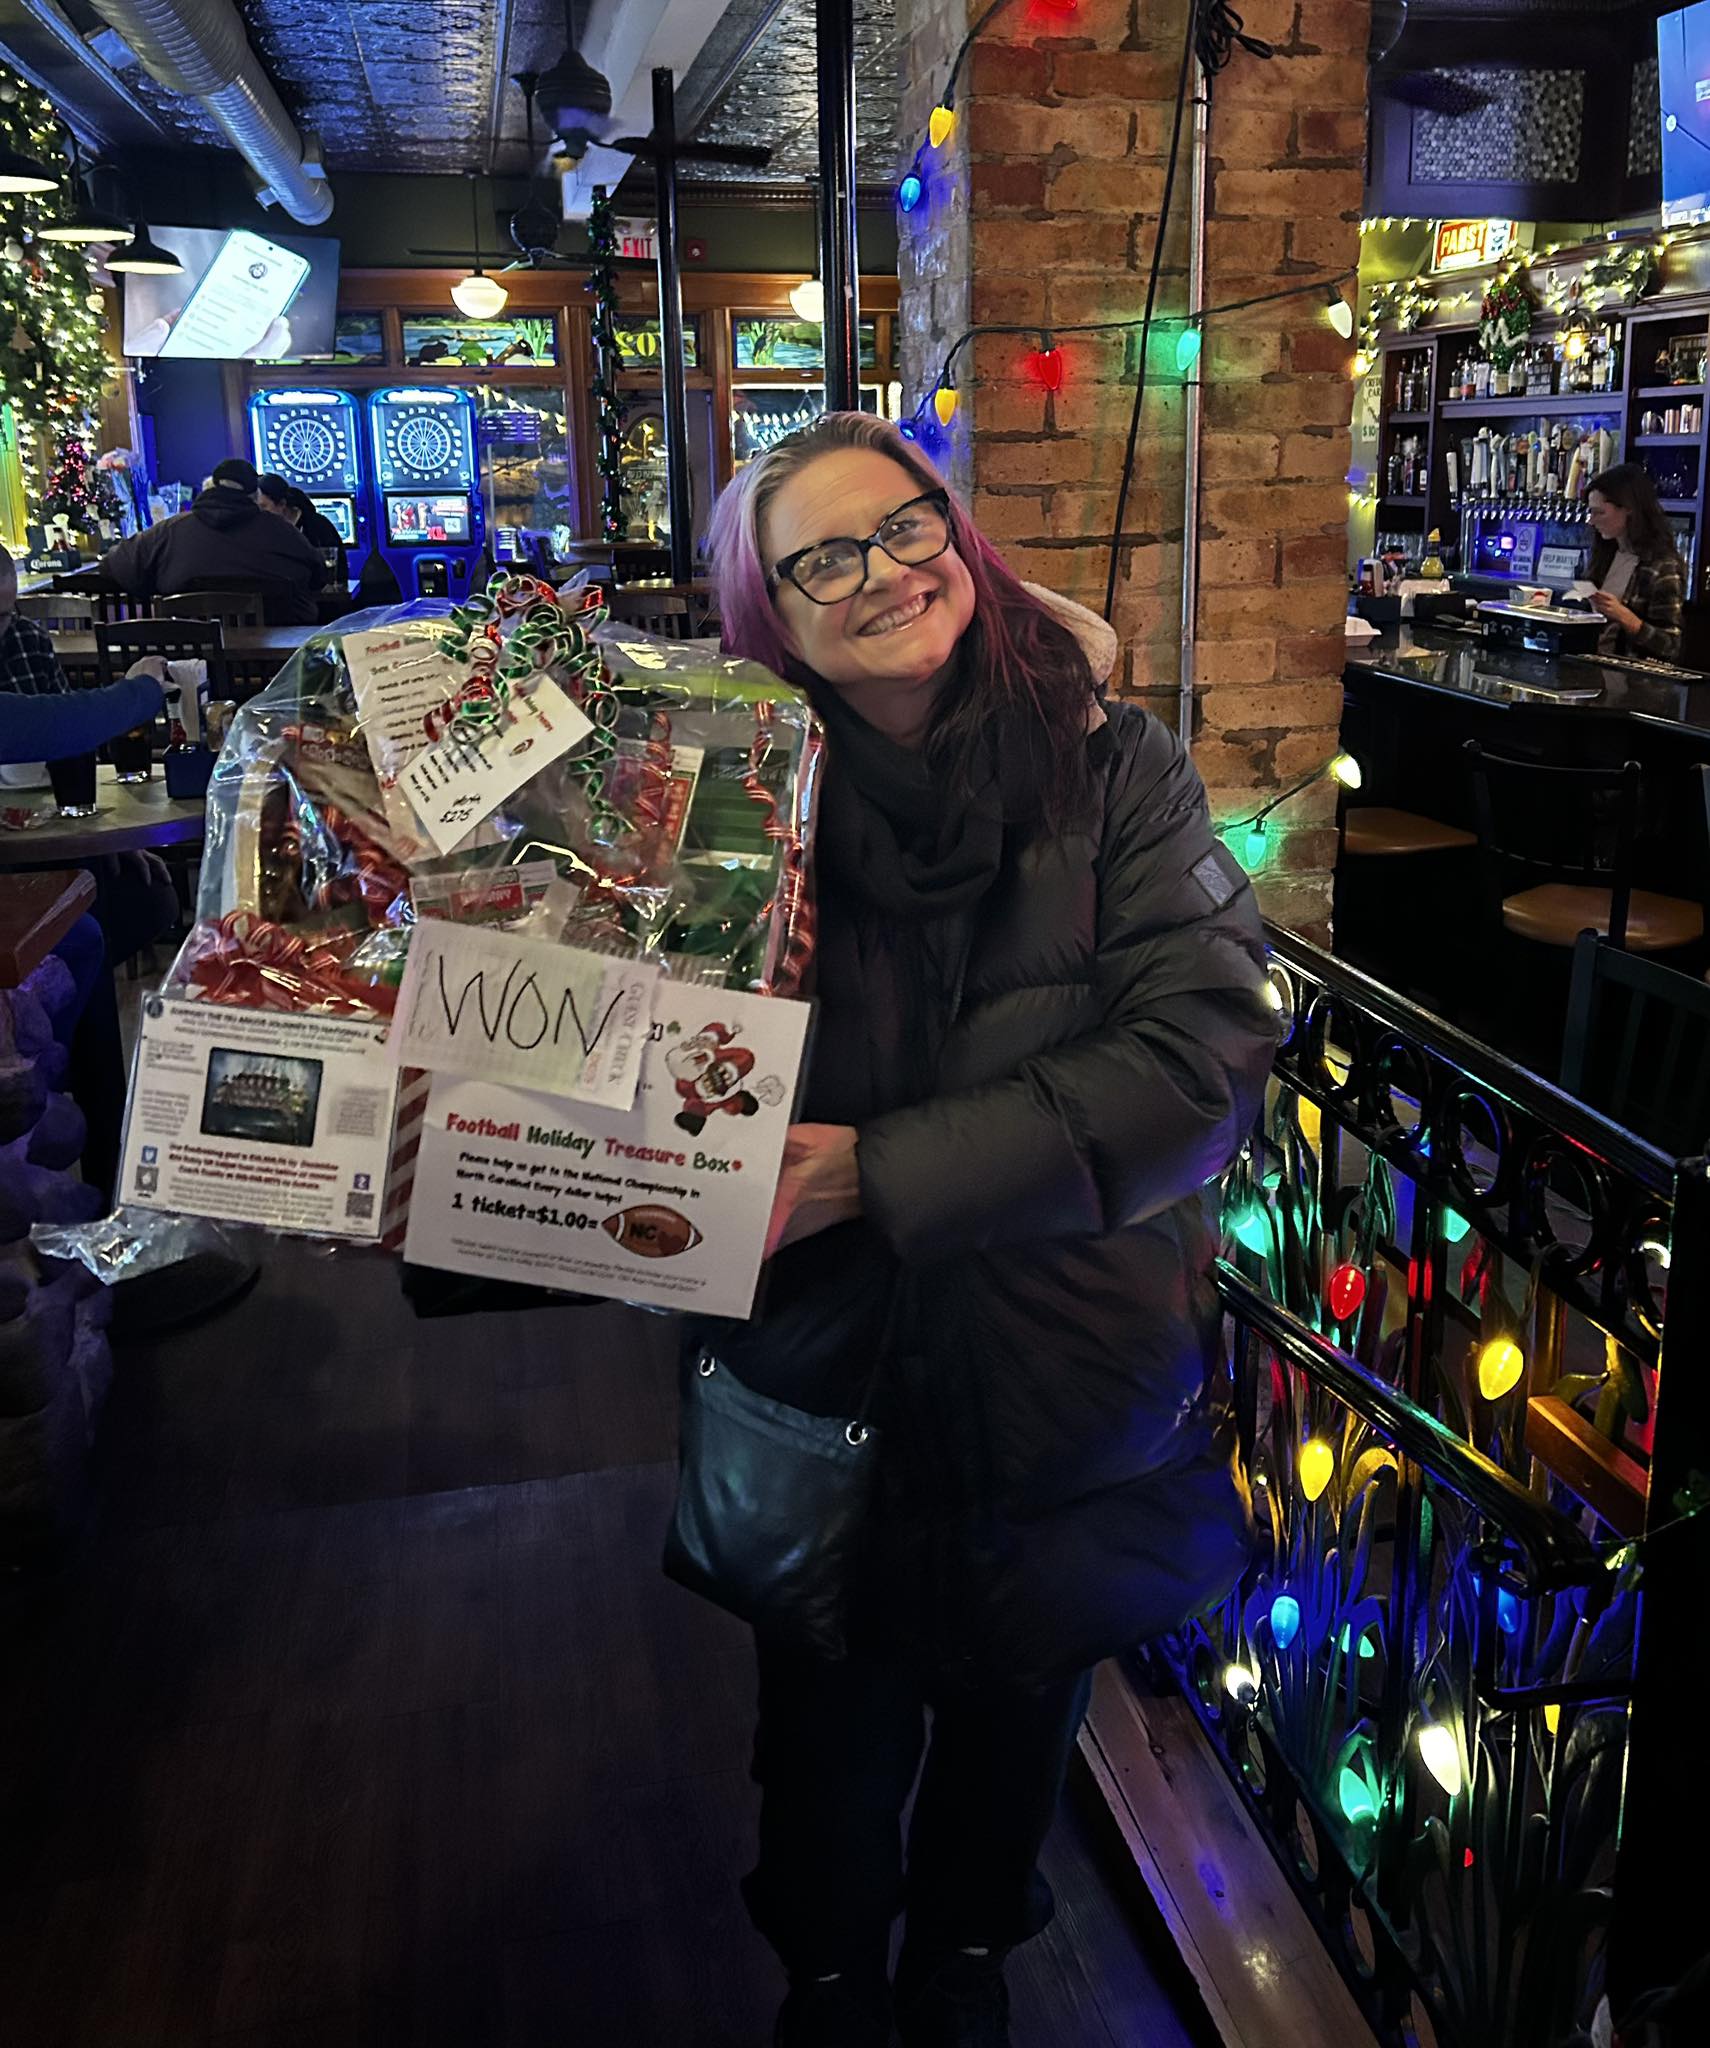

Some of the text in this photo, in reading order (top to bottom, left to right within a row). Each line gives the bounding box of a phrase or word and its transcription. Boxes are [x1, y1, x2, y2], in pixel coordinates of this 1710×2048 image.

[623, 237, 652, 258] EXIT
[1440, 223, 1488, 256] PABST
[30, 558, 63, 570] Corona
[438, 954, 625, 1057] WON
[446, 1112, 520, 1141] Football
[526, 1125, 595, 1159] Holiday
[605, 1137, 686, 1167] Treasure
[459, 1151, 490, 1165] Please
[493, 1157, 513, 1173] help
[530, 1165, 547, 1177] get
[563, 1168, 578, 1179] the
[625, 1178, 687, 1199] Championship
[452, 1193, 463, 1209] 1
